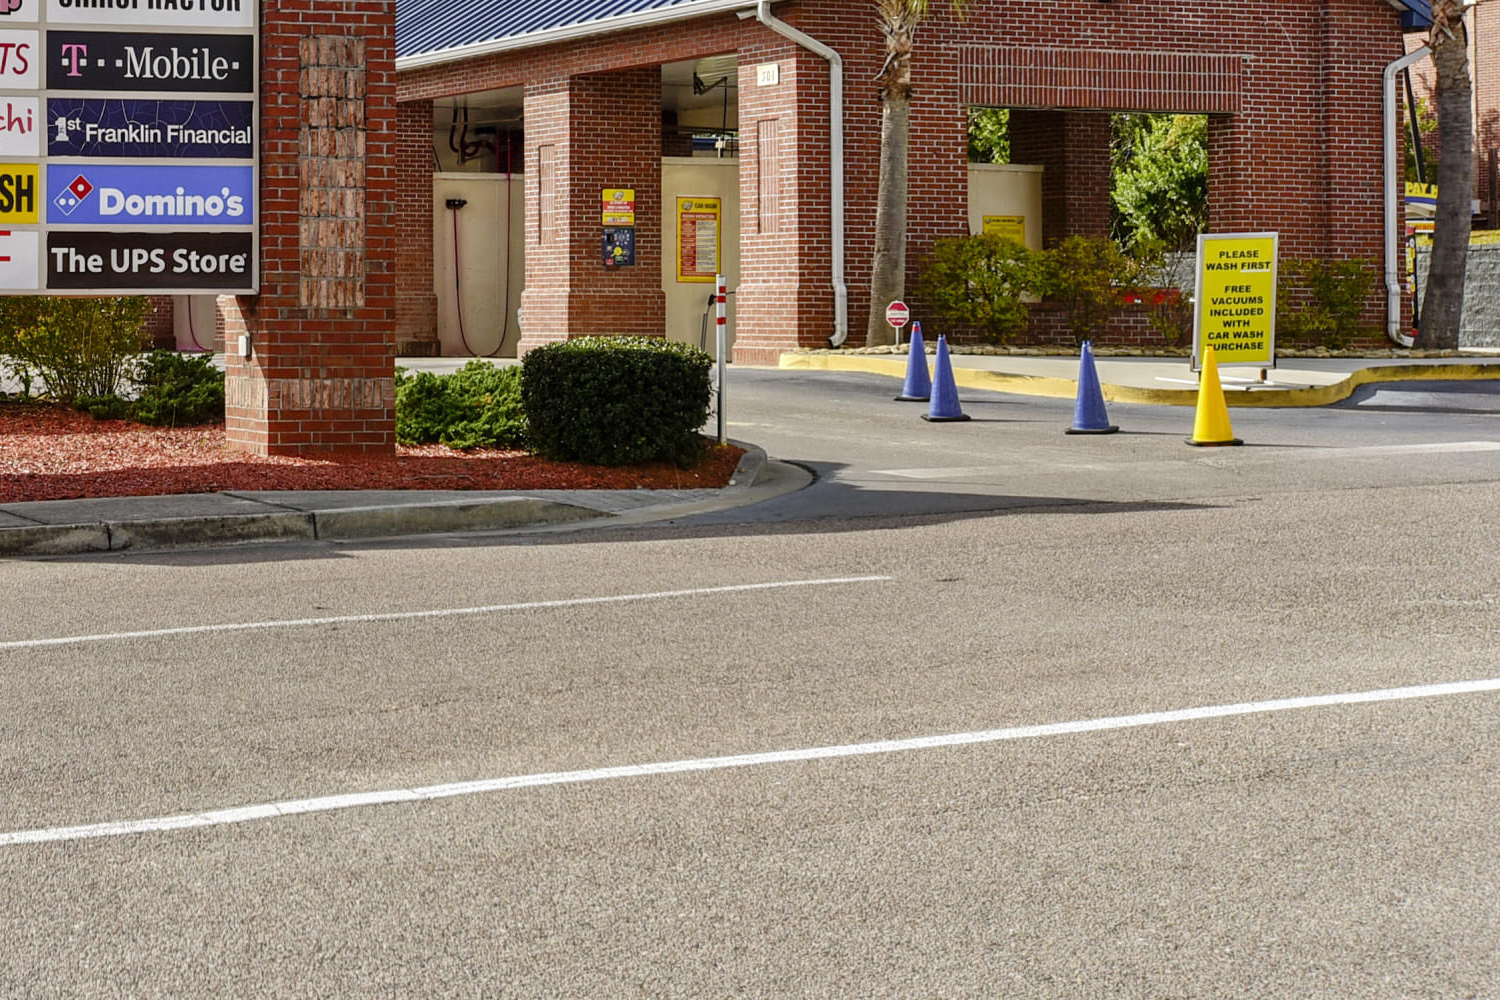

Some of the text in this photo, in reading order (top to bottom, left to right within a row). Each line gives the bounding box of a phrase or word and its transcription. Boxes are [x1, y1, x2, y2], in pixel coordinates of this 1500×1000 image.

[55, 117, 251, 144] 1st Franklin Financial
[100, 186, 244, 217] Domino's
[1219, 250, 1259, 258] PLEASE
[51, 247, 246, 274] The UPS Store
[1241, 261, 1271, 270] FIRST
[1224, 285, 1252, 293] FREE
[1211, 296, 1264, 305] VACUUMS
[1210, 308, 1264, 316] INCLUDED
[1208, 331, 1264, 340] CAR WASH
[1206, 342, 1264, 351] URCHASE
